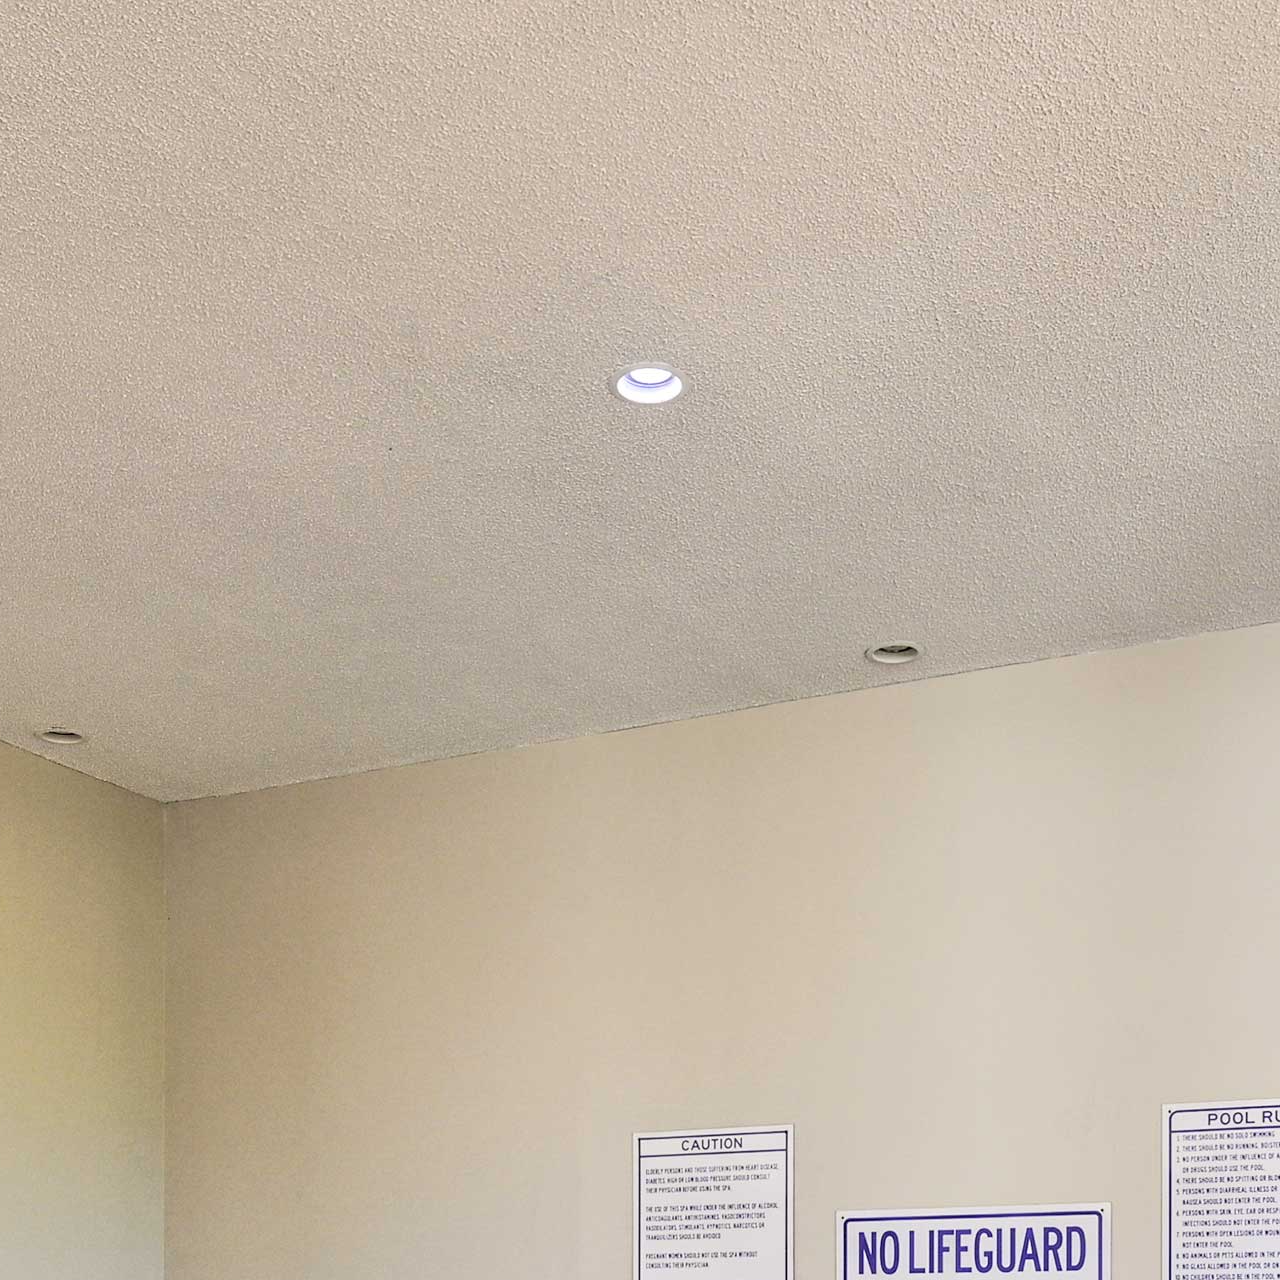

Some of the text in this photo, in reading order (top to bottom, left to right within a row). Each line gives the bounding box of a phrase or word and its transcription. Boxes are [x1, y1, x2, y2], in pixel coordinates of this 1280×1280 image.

[1208, 1111, 1254, 1125] POOL
[682, 1138, 742, 1151] CAUTION
[859, 1226, 1086, 1274] NO LIFEGUARD
